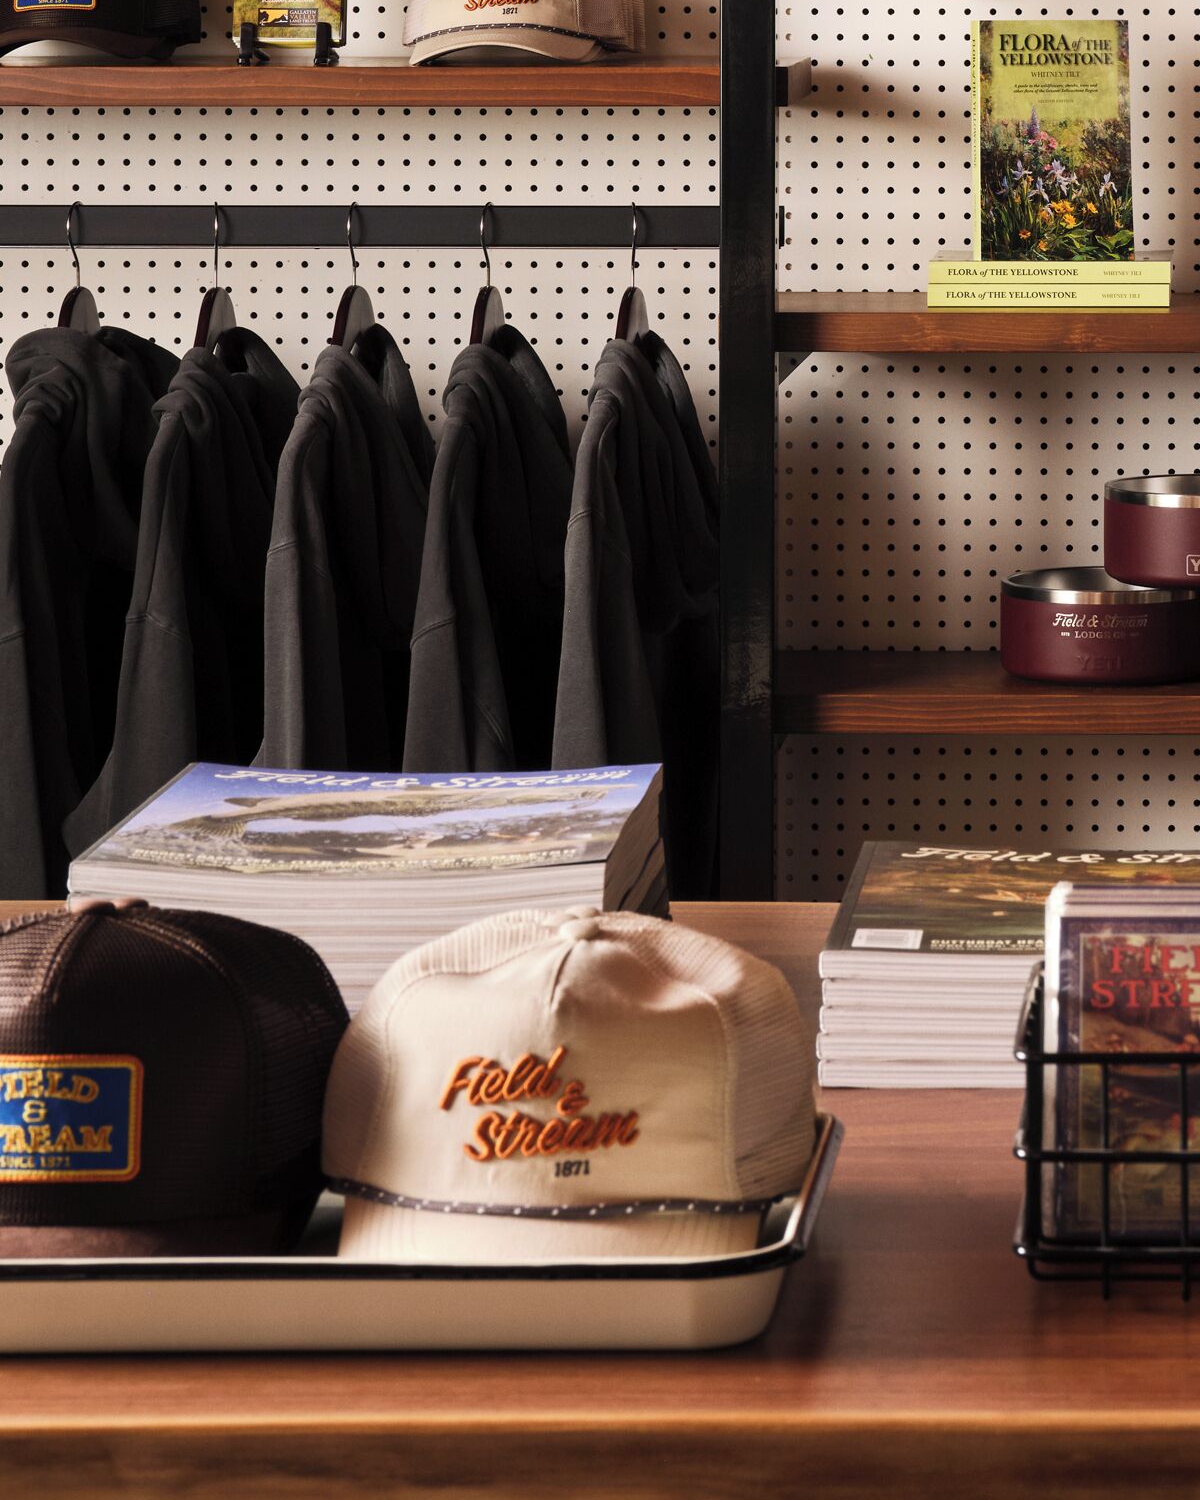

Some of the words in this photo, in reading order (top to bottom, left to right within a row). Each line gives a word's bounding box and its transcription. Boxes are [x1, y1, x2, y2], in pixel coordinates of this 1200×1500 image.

[502, 7, 518, 15] 1871
[999, 33, 1071, 51] FLORA
[1071, 37, 1083, 50] of
[1084, 39, 1112, 51] THE
[999, 52, 1113, 66] YELLOWSTONE
[948, 268, 978, 276] FLORA
[980, 268, 988, 277] of
[990, 268, 1008, 276] THE
[1011, 268, 1079, 276] YELLOWSTONE
[946, 291, 976, 299] FLORA
[978, 291, 987, 300] of
[988, 291, 1007, 299] THE
[1009, 291, 1077, 299] YELLOWSTONE
[1053, 613, 1086, 628] Field
[1087, 614, 1099, 628] &
[1101, 614, 1148, 628] Stream
[1074, 630, 1111, 639] LODGE
[215, 769, 373, 788] Field
[371, 776, 421, 789] &
[431, 769, 631, 789] Stream
[902, 847, 1052, 863] Field
[1056, 852, 1106, 864] &
[0, 1068, 99, 1104] IELD
[440, 1045, 567, 1111] Field
[556, 1079, 591, 1116] &
[464, 1109, 640, 1163] Stream
[40, 1155, 71, 1168] 1871
[554, 1160, 591, 1178] 1871
